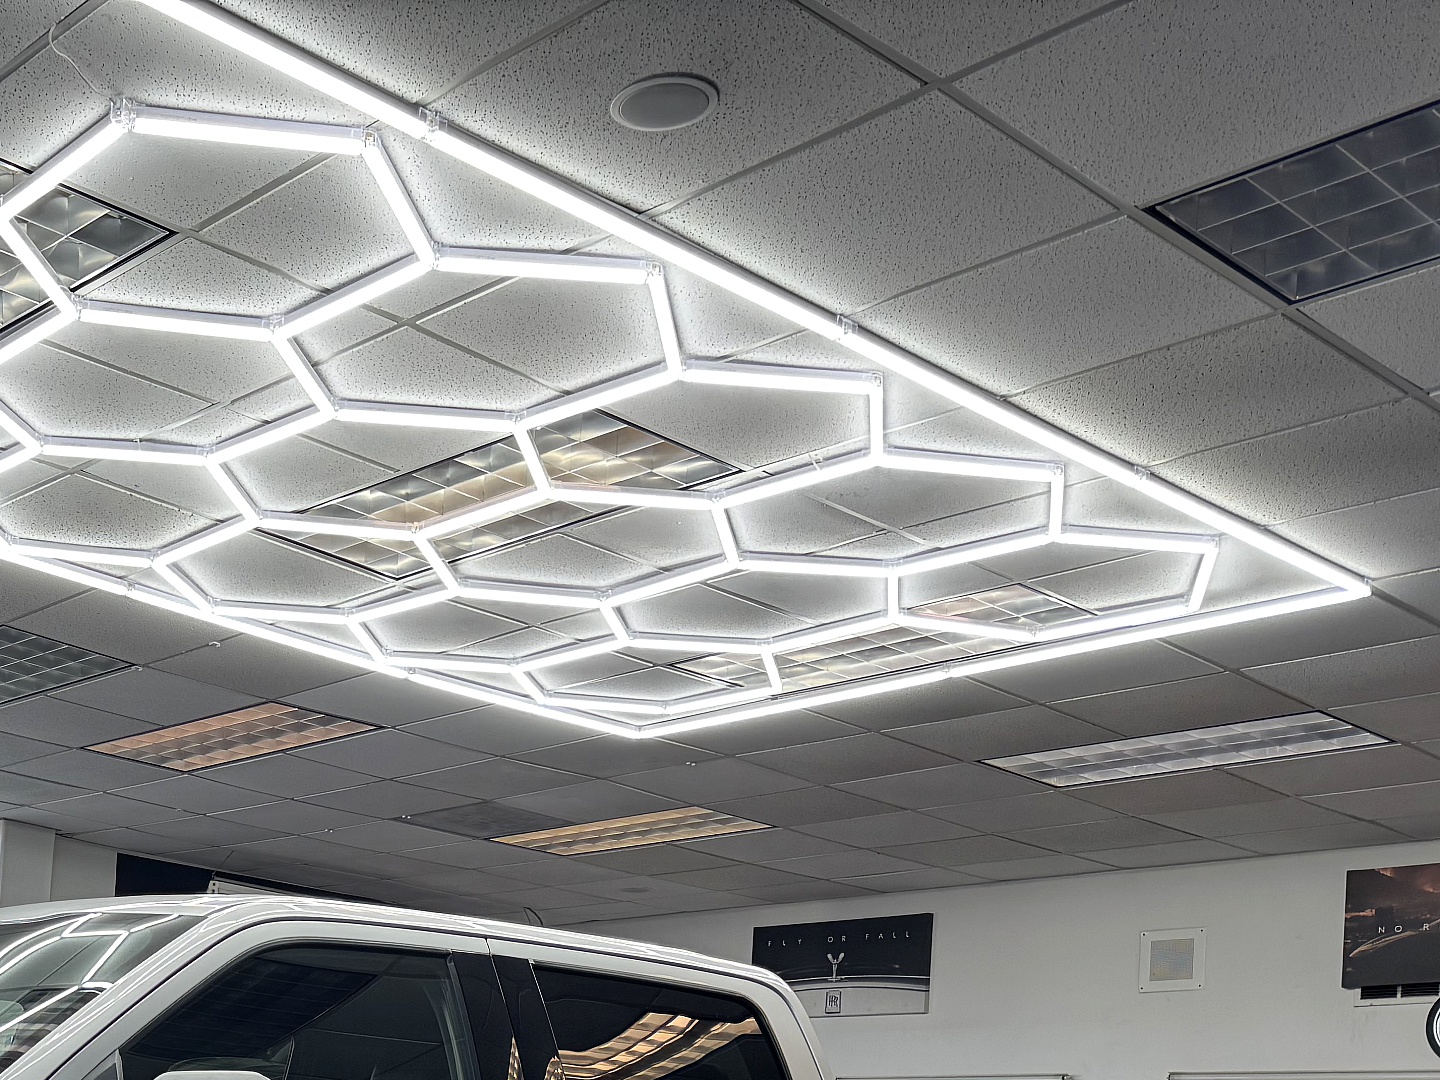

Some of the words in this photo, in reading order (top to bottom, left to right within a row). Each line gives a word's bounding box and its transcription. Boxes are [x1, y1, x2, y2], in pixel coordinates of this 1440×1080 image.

[767, 938, 802, 947] FLY
[827, 935, 846, 943] OR
[865, 931, 911, 941] FALL
